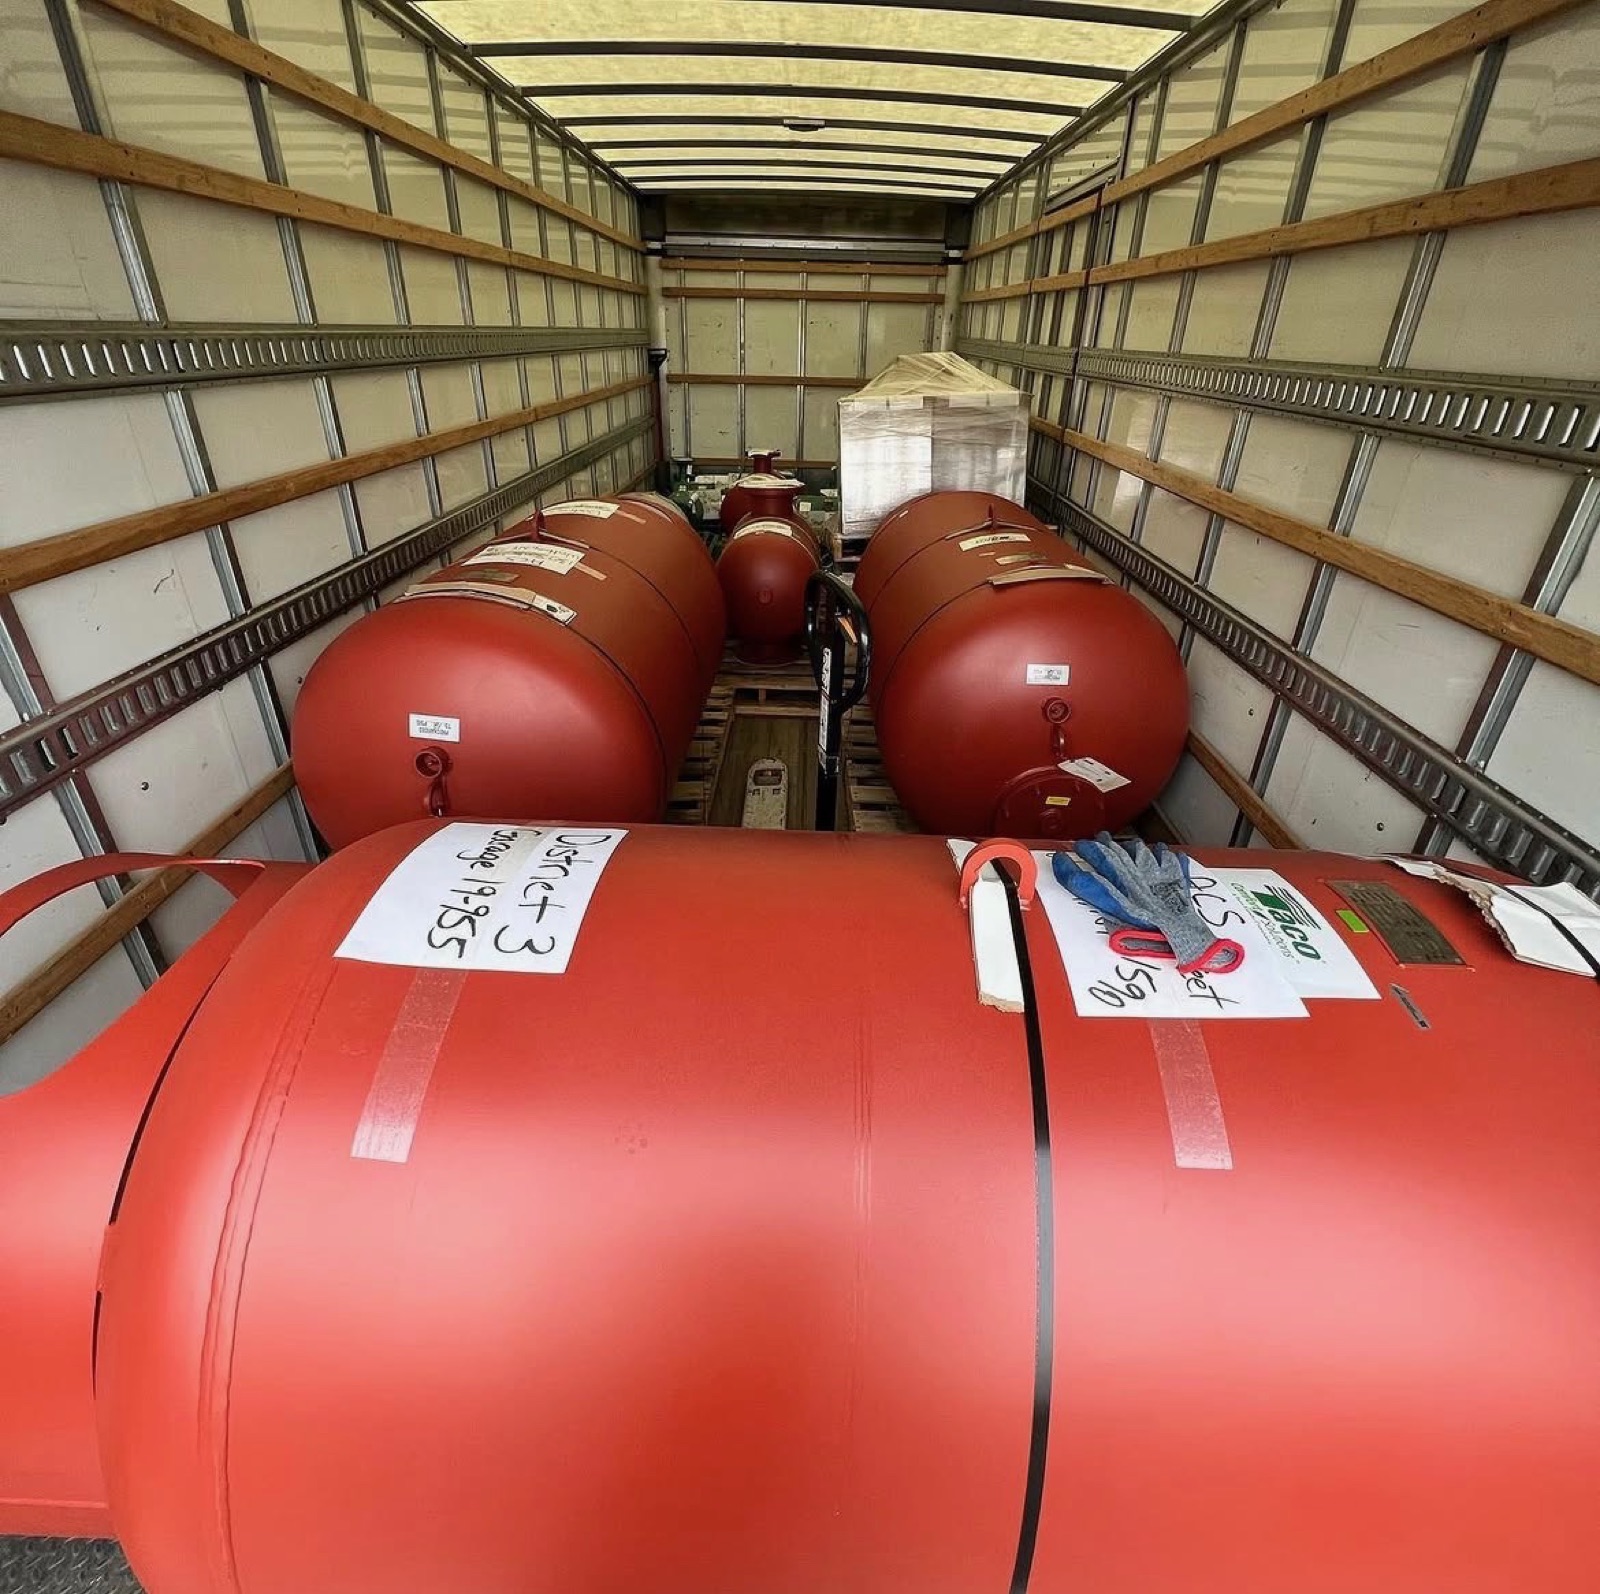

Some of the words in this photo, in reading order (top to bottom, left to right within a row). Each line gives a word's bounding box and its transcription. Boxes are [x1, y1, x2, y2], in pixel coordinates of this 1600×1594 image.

[456, 829, 543, 870] Garage
[517, 834, 612, 924] District
[427, 877, 506, 959] 19-955
[494, 924, 556, 955] 3
